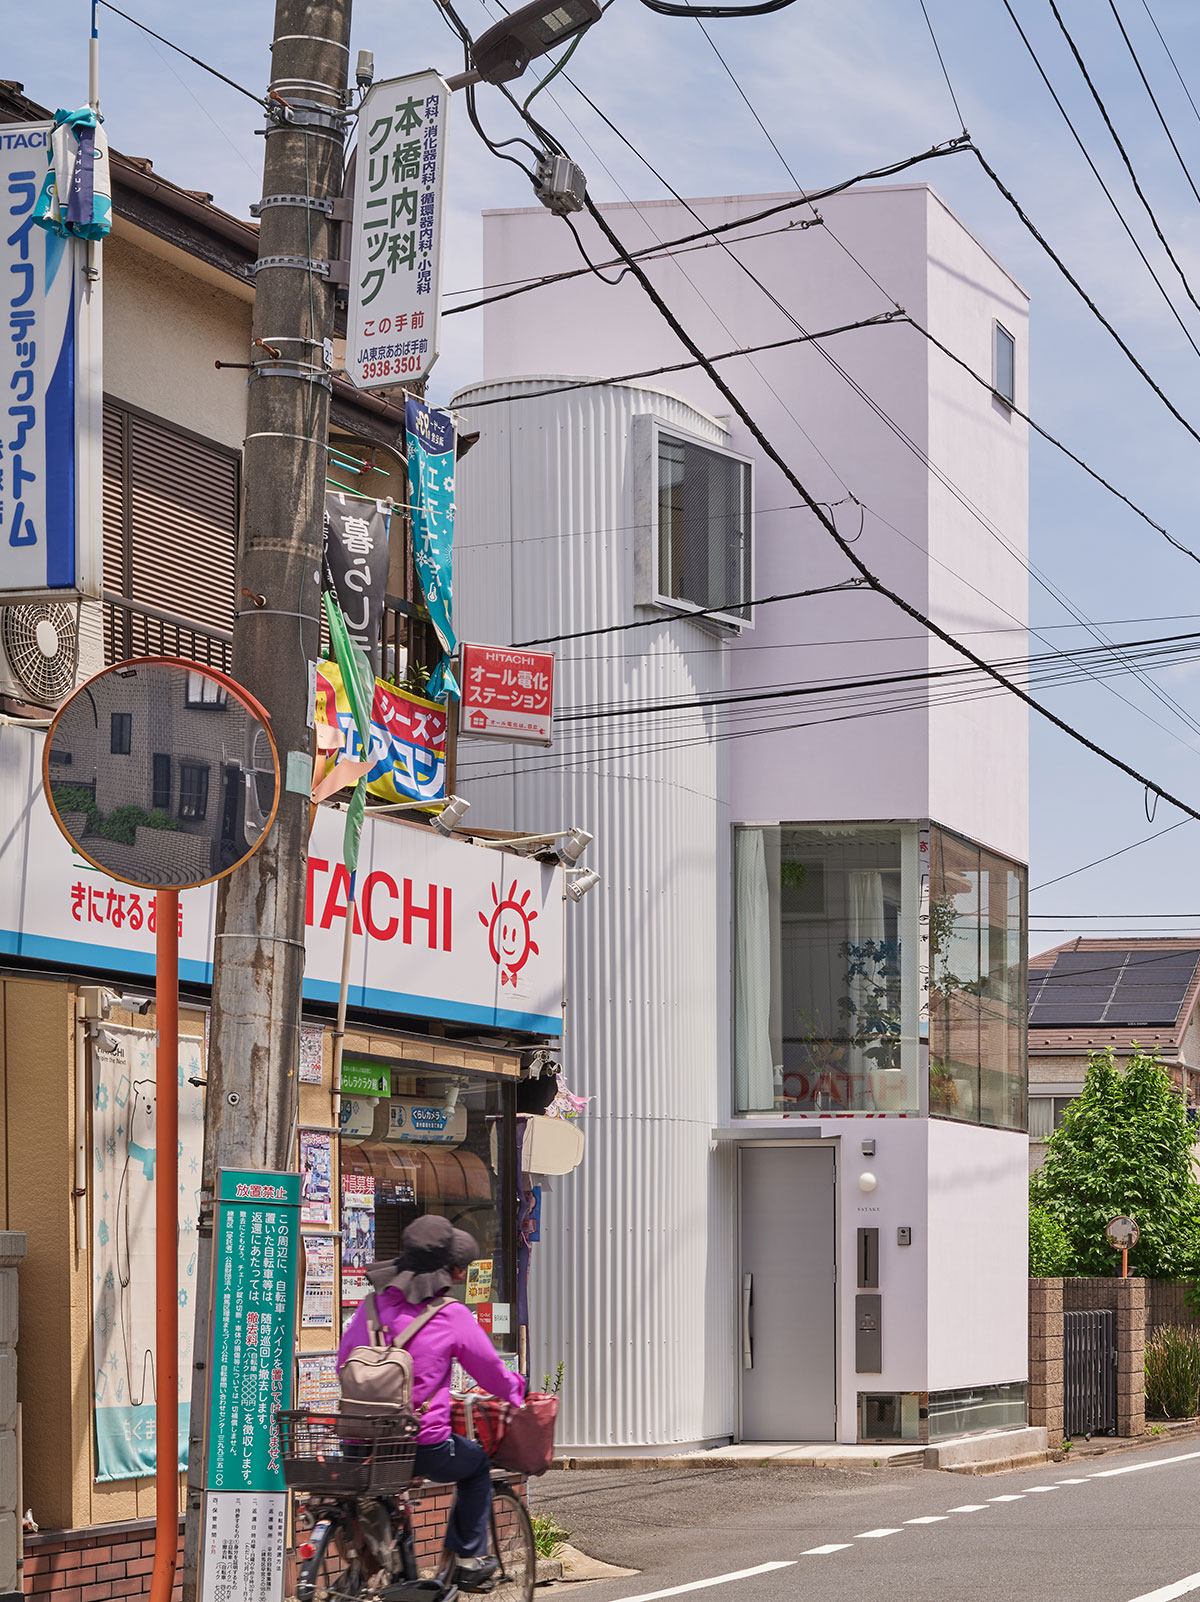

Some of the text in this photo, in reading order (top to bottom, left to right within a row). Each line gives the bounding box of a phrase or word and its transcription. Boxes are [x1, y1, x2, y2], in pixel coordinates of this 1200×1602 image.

[0, 132, 47, 149] ITAC
[387, 95, 424, 274] 本橋内科
[360, 115, 393, 307] クリニック
[363, 310, 425, 337] この手前
[7, 170, 37, 548] ライフテックアトム
[357, 338, 428, 364] JA東京あおば手前
[485, 652, 535, 666] HITACHI
[470, 665, 549, 691] オール電化
[469, 685, 548, 709] ステーション
[380, 694, 446, 746] シーズン
[340, 1074, 378, 1092] らしラクラク館
[235, 1183, 288, 1200] 放置禁止
[257, 1212, 276, 1430] 置いた自転車等は、随時巡回し撤去します。
